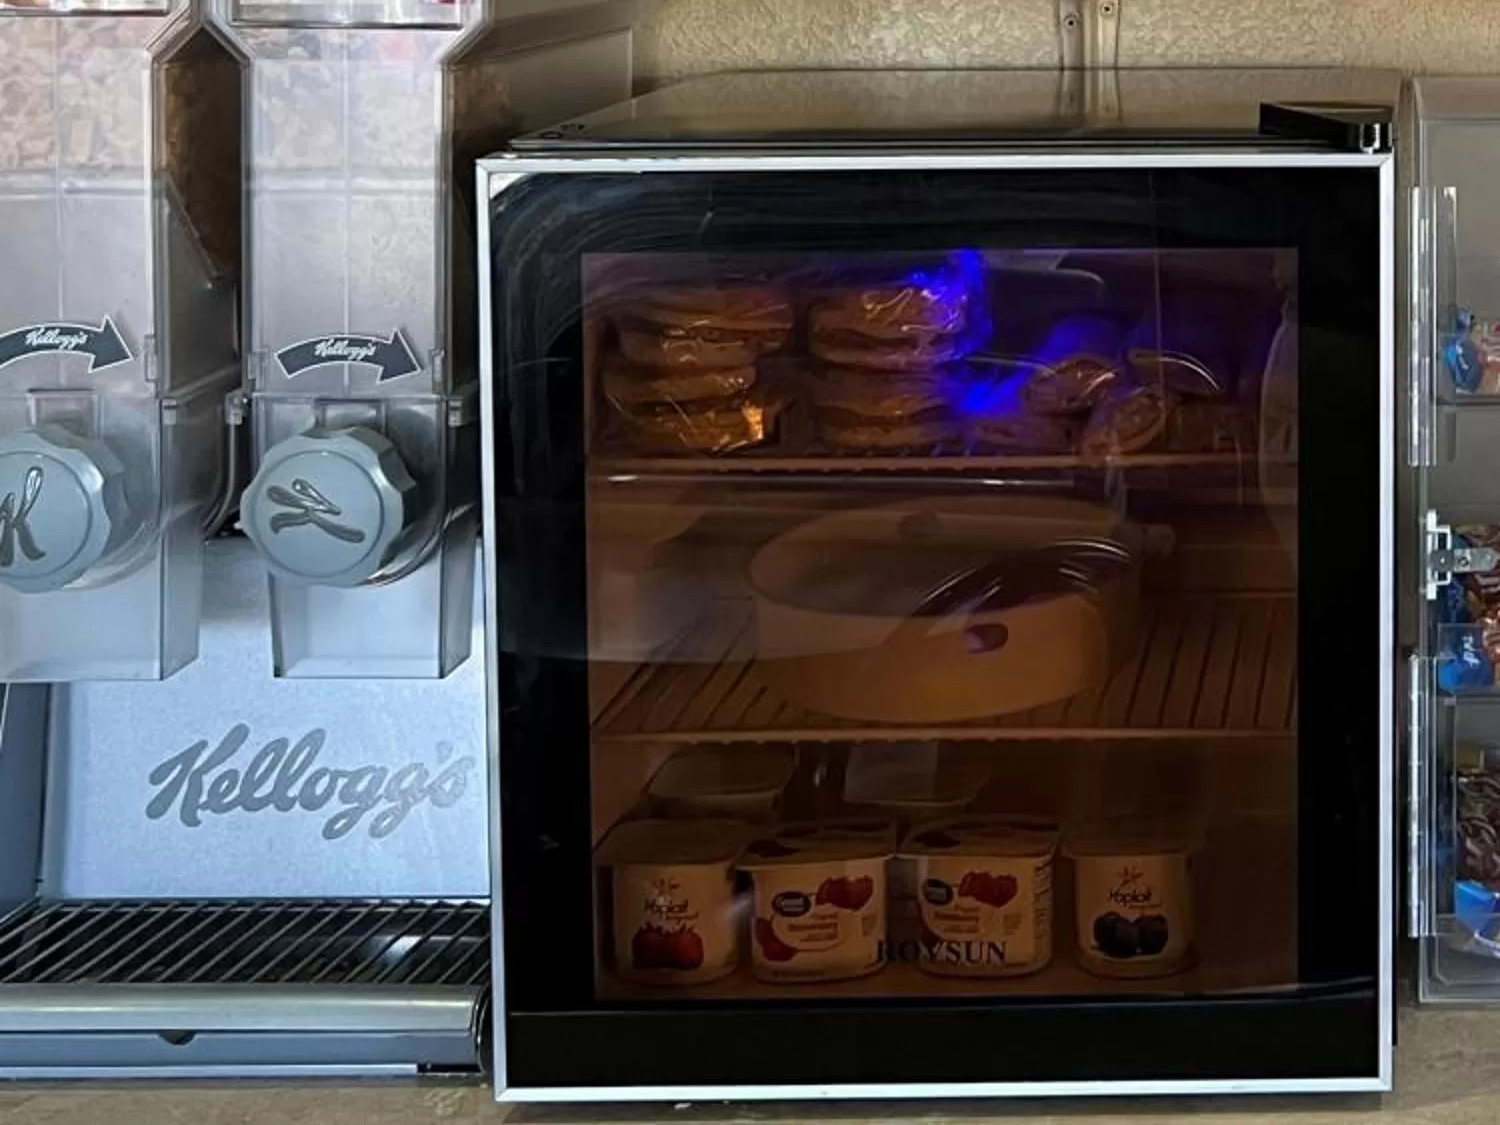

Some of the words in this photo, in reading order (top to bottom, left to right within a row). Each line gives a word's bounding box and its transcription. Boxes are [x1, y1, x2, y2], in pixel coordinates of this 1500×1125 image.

[25, 327, 89, 349] Kellogg's
[314, 338, 377, 360] Kellogg's
[145, 723, 476, 840] Kellogg's
